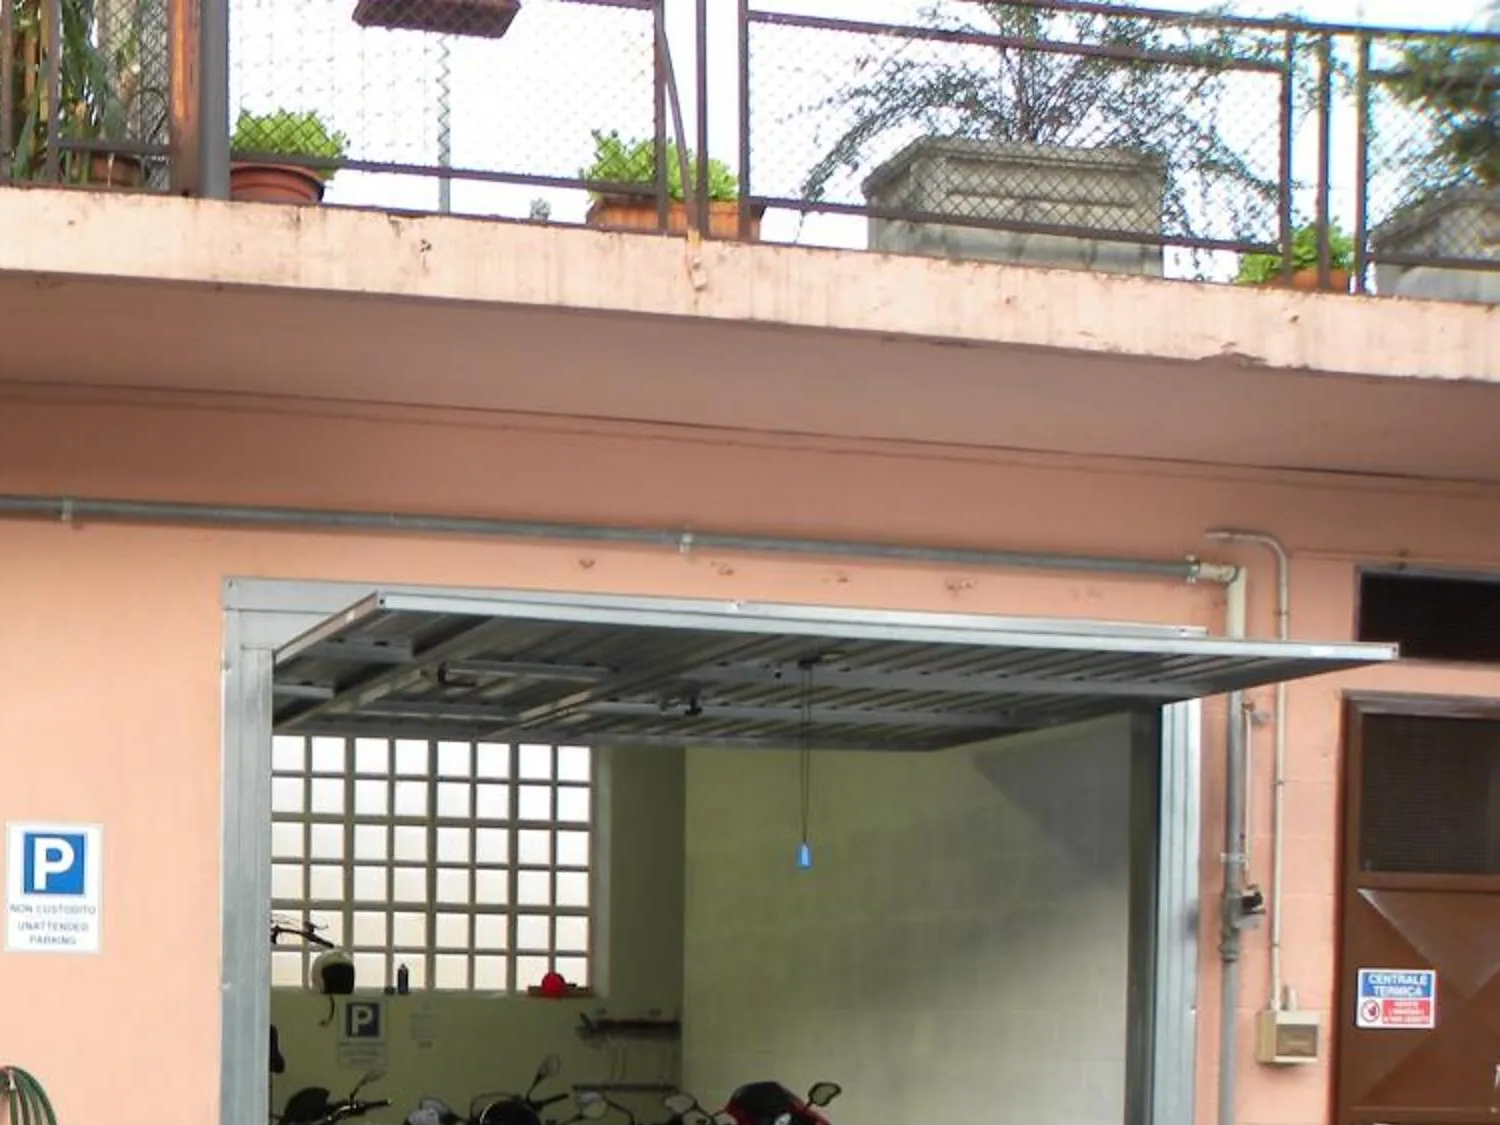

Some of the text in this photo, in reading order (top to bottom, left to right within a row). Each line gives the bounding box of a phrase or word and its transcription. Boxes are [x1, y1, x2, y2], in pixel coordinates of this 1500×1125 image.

[34, 837, 75, 890] P
[9, 903, 97, 915] NON CUSTODITO
[17, 920, 90, 932] UNATTENDED
[29, 935, 77, 945] PARKING
[1368, 973, 1429, 985] CENTRALE
[1372, 985, 1423, 997] TERMICA
[351, 1005, 373, 1036] P
